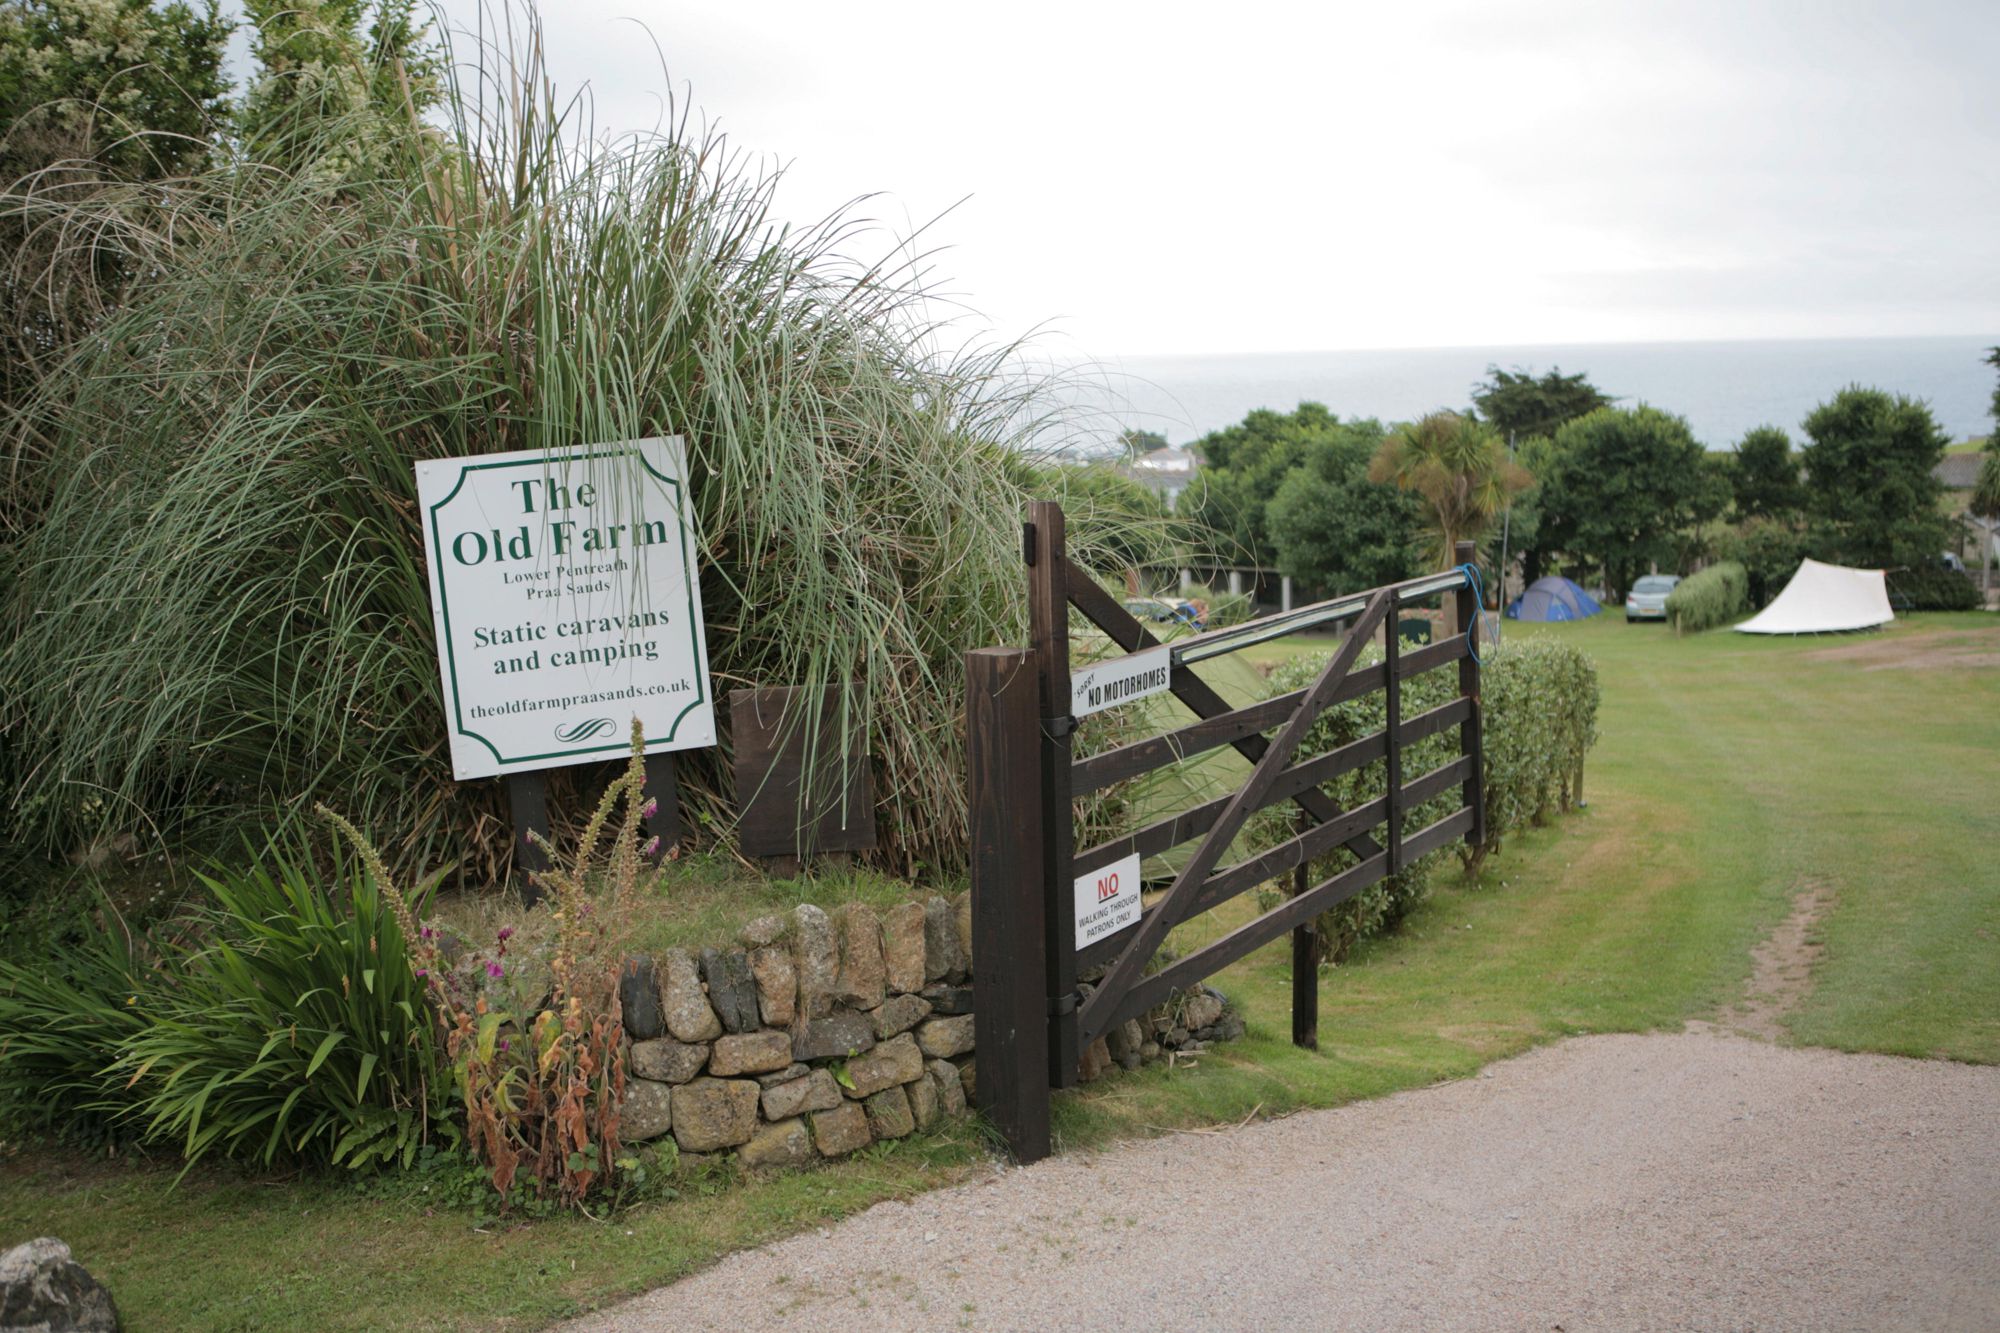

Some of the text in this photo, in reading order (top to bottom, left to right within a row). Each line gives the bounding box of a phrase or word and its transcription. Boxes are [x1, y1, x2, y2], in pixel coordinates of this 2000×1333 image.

[512, 477, 597, 514] The
[452, 519, 669, 566] Old Farm
[503, 559, 629, 585] Lower Pentreath
[526, 580, 611, 601] Praa Sands
[473, 609, 670, 651] Static caravans
[493, 639, 659, 676] and camping
[470, 679, 691, 719] theoldfarmpraasands.co.uk
[1088, 667, 1166, 708] NO MOTORHOMES
[1098, 873, 1119, 900] NO
[1079, 893, 1138, 928] WALKING THROUGH
[1087, 910, 1131, 938] PATRONS ONLY
